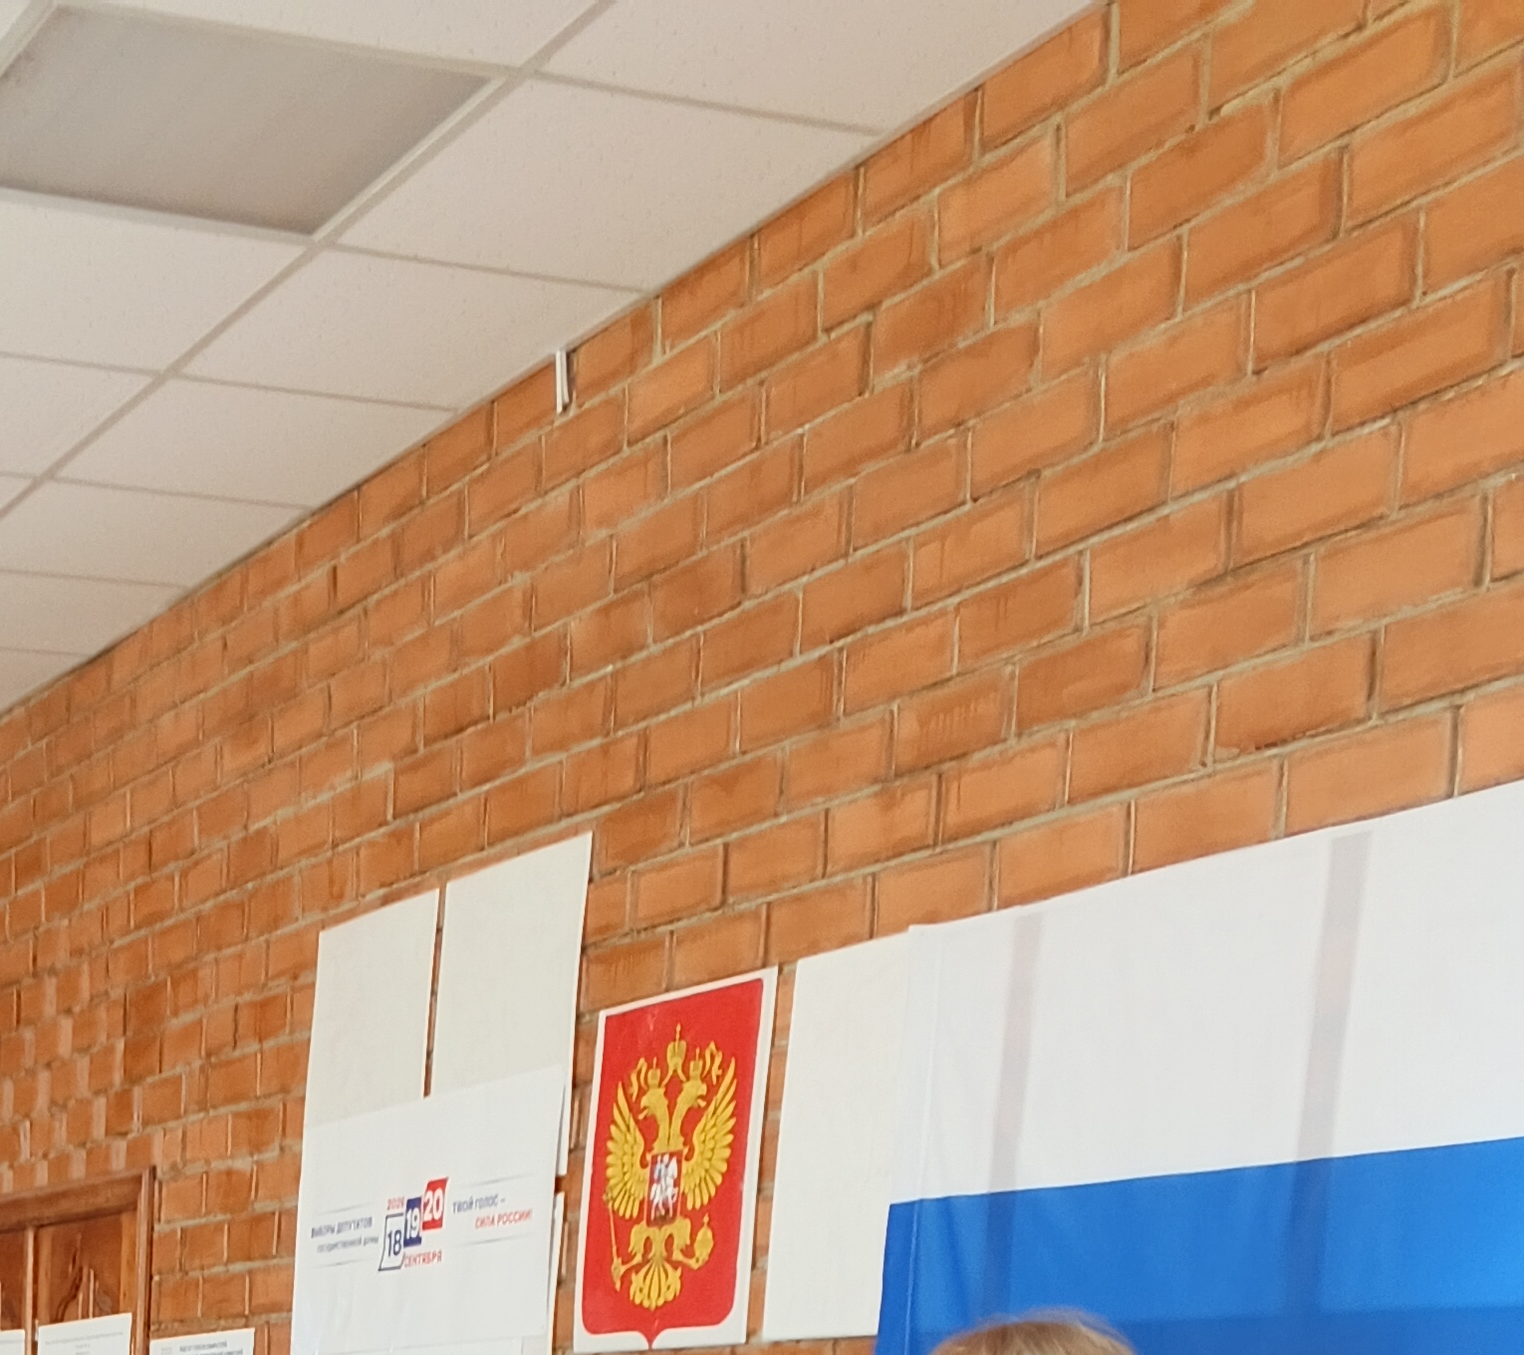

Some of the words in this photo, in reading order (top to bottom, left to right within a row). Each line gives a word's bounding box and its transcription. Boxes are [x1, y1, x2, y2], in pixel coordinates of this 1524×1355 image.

[423, 1187, 443, 1222] 20
[406, 1207, 421, 1240] 19
[387, 1229, 402, 1257] 18
